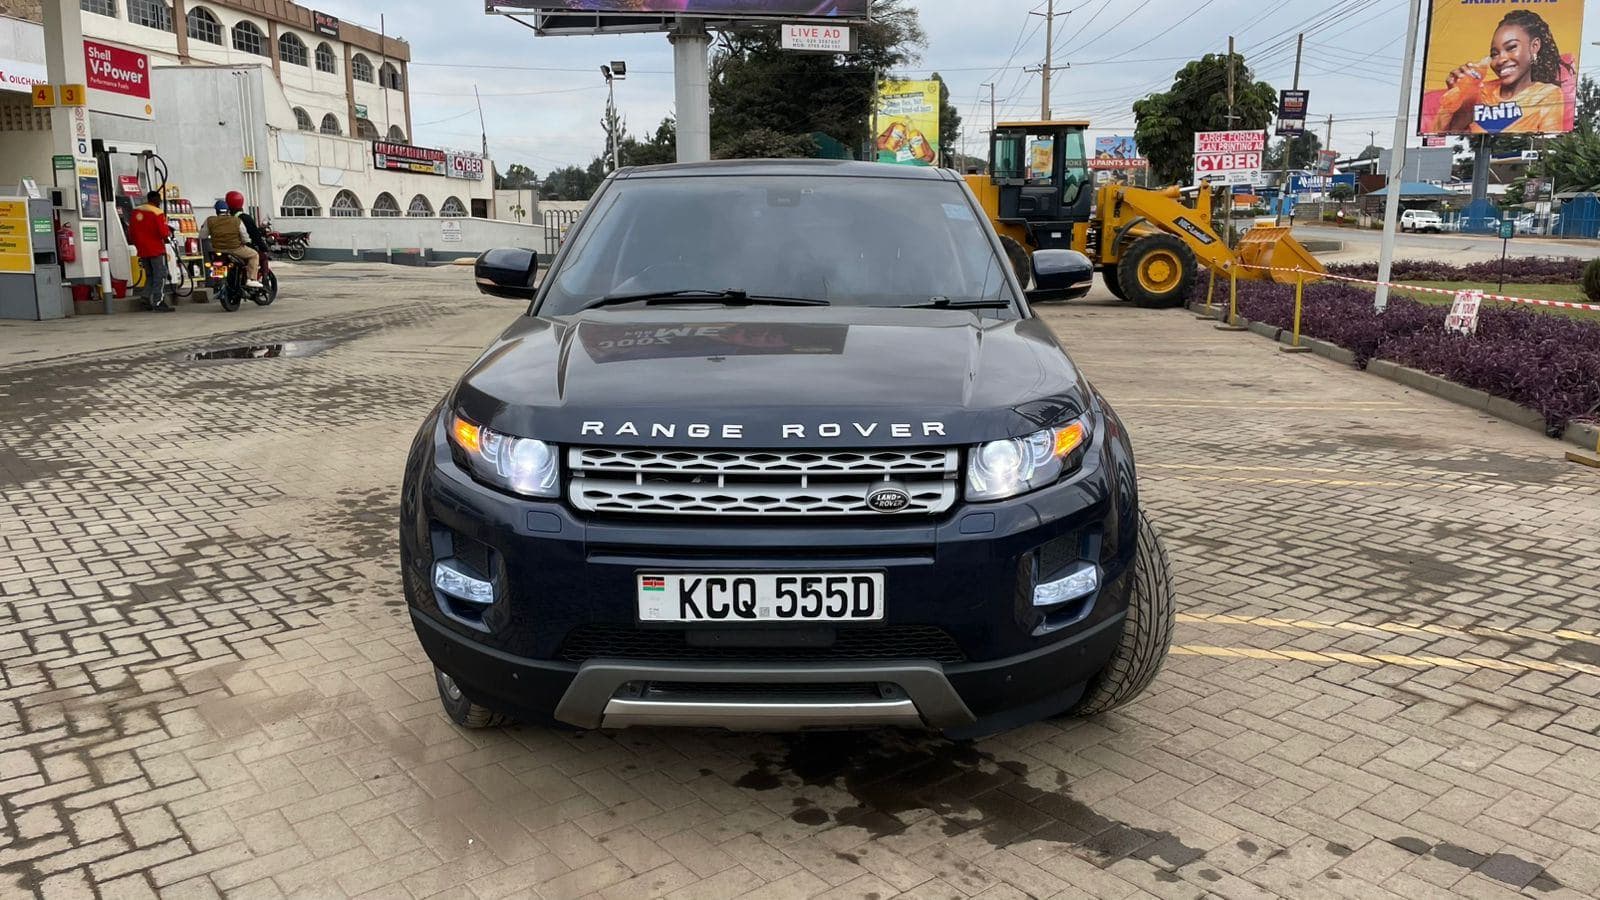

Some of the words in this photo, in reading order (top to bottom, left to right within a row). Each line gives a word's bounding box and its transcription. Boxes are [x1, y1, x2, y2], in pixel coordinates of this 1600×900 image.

[791, 28, 818, 37] LIVE
[824, 30, 841, 38] AD
[88, 46, 111, 61] Shell
[90, 59, 143, 84] V-Power
[37, 90, 46, 101] 4
[66, 89, 74, 101] 3
[1474, 102, 1521, 121] FANTA
[1218, 142, 1252, 150] PRINTING
[455, 157, 482, 172] CYBER
[1197, 153, 1258, 170] CYBER
[581, 421, 743, 438] RANGE
[782, 421, 946, 438] ROVER
[679, 578, 757, 619] KCQ
[775, 576, 875, 618] 555D
